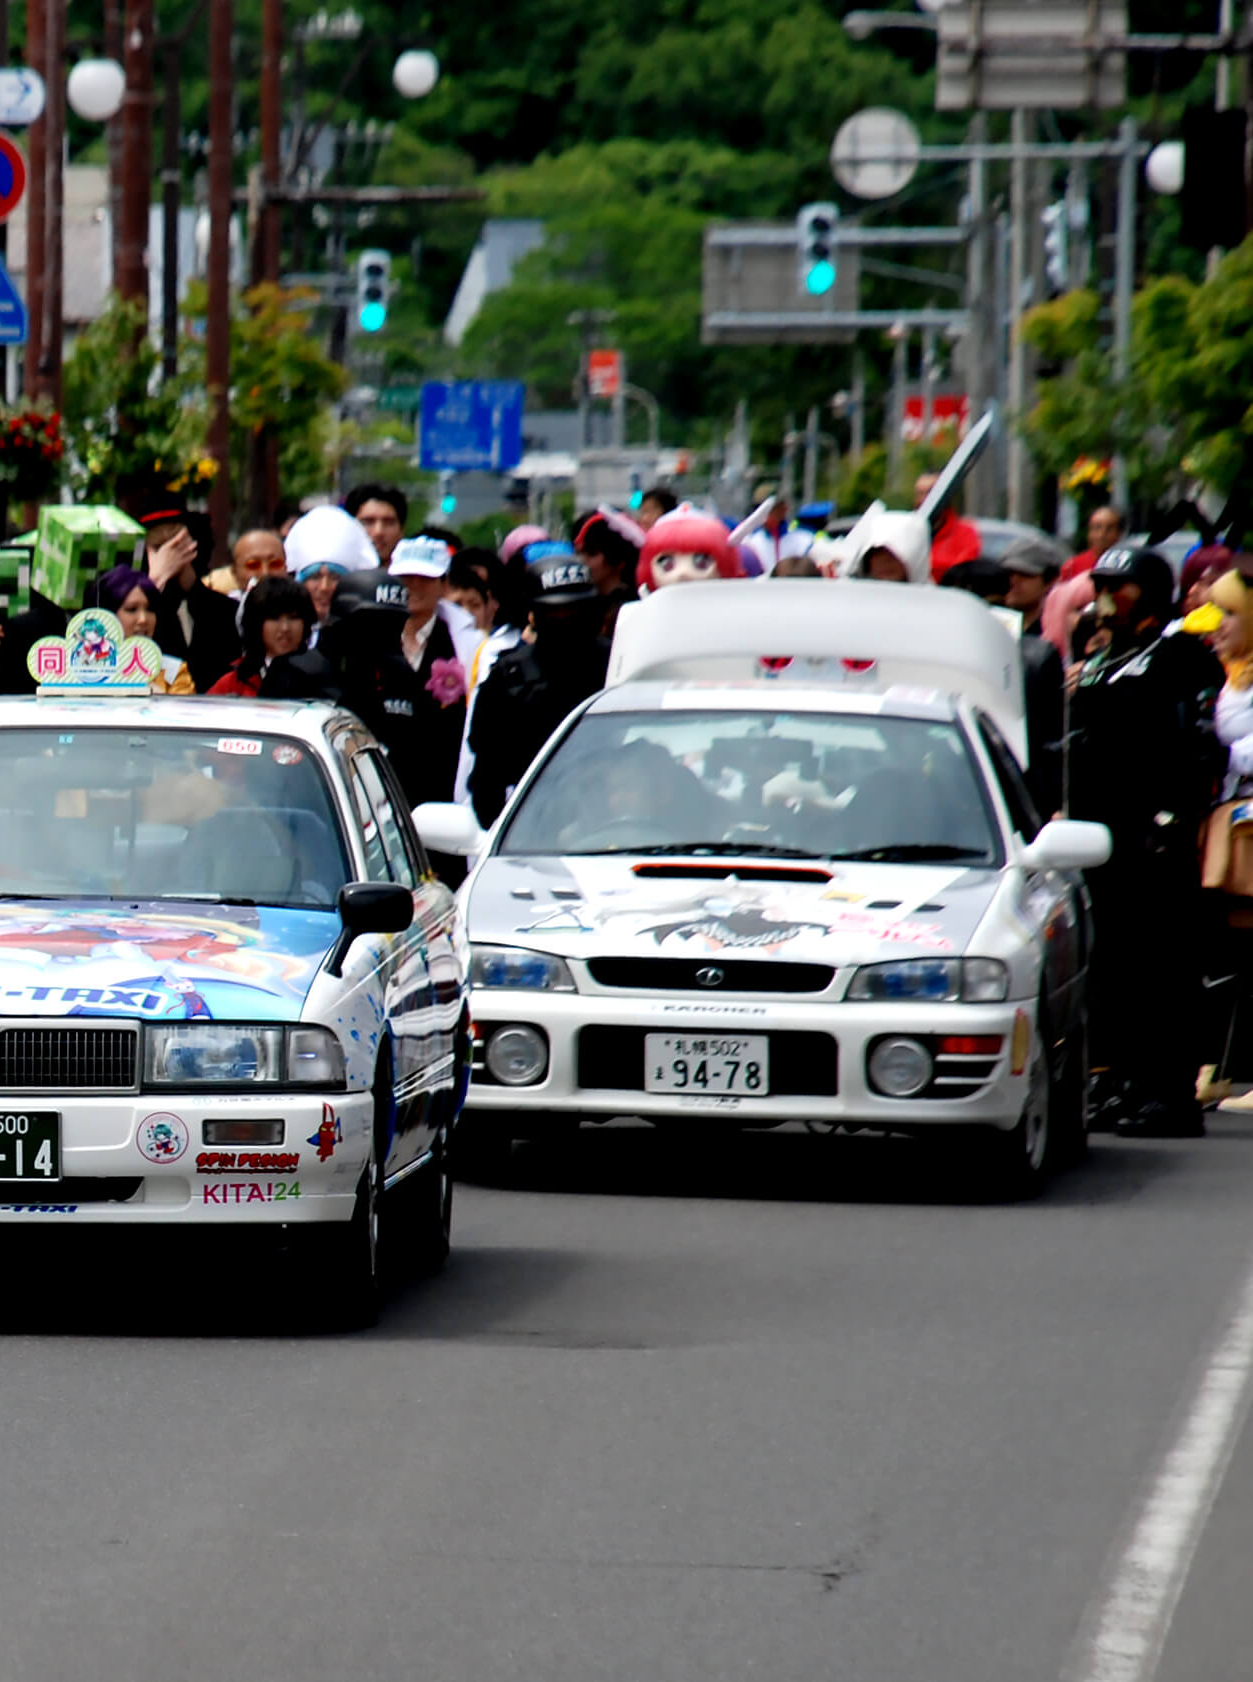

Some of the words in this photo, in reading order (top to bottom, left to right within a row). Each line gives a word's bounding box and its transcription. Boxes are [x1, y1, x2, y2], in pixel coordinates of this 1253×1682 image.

[38, 647, 65, 675] 同
[122, 647, 151, 675] 人
[672, 1059, 761, 1090] 94-78
[203, 1181, 302, 1205] KITA!24
